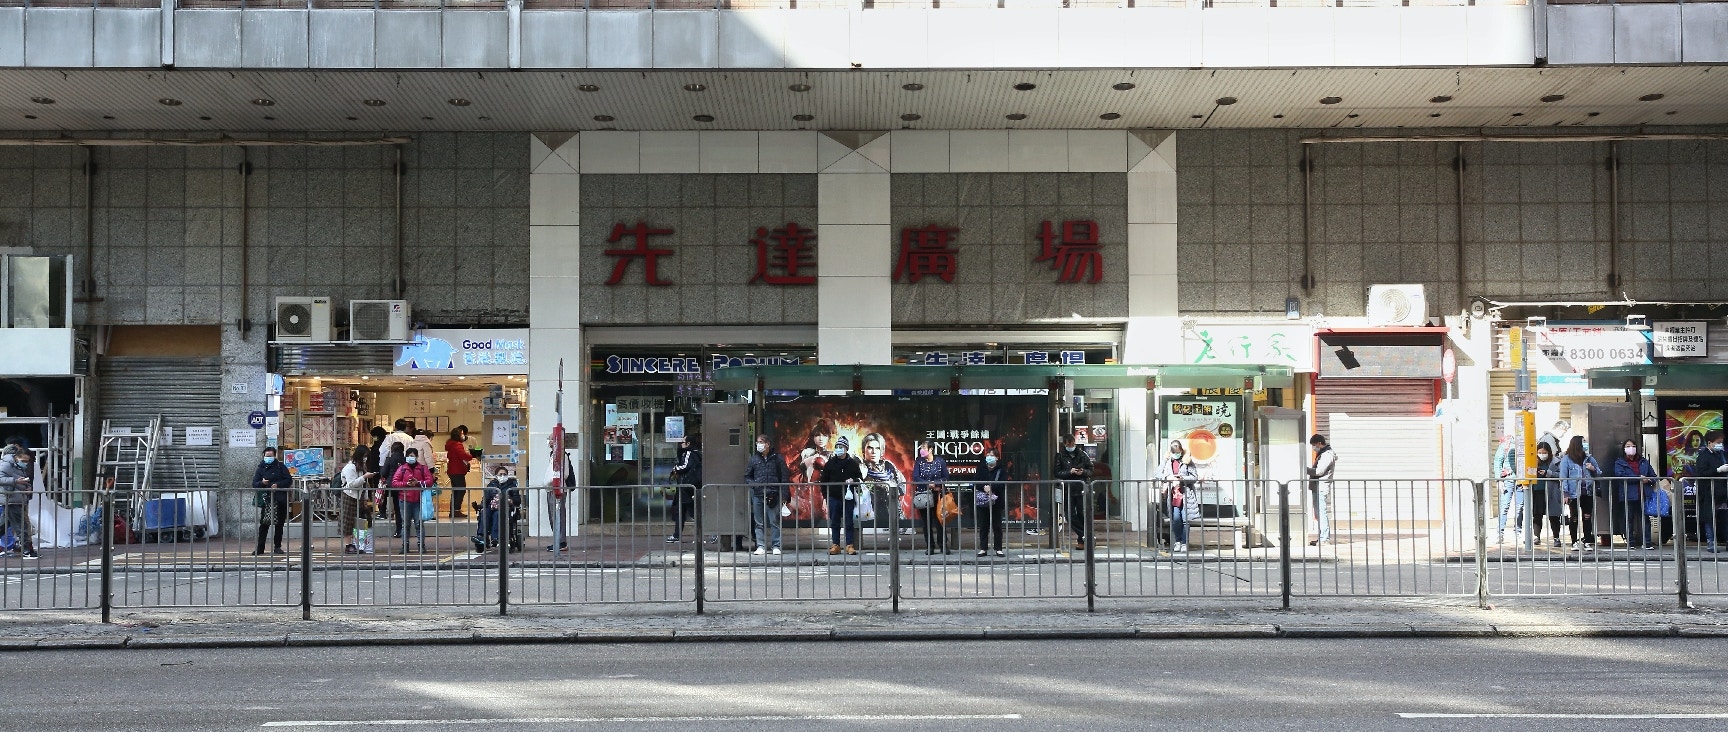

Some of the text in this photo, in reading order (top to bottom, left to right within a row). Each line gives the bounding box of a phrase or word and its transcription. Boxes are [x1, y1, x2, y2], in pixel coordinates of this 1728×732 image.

[604, 221, 1104, 286] 先達廣場
[462, 338, 525, 350] Good Mask
[1570, 348, 1605, 360] 8300
[1609, 347, 1644, 360] 0634
[606, 354, 701, 373] SINCERE
[617, 398, 665, 410] 高價收機
[251, 416, 263, 425] ADT
[925, 429, 990, 439] 王國:戰爭餘燼
[914, 439, 1003, 460] KNGDOM
